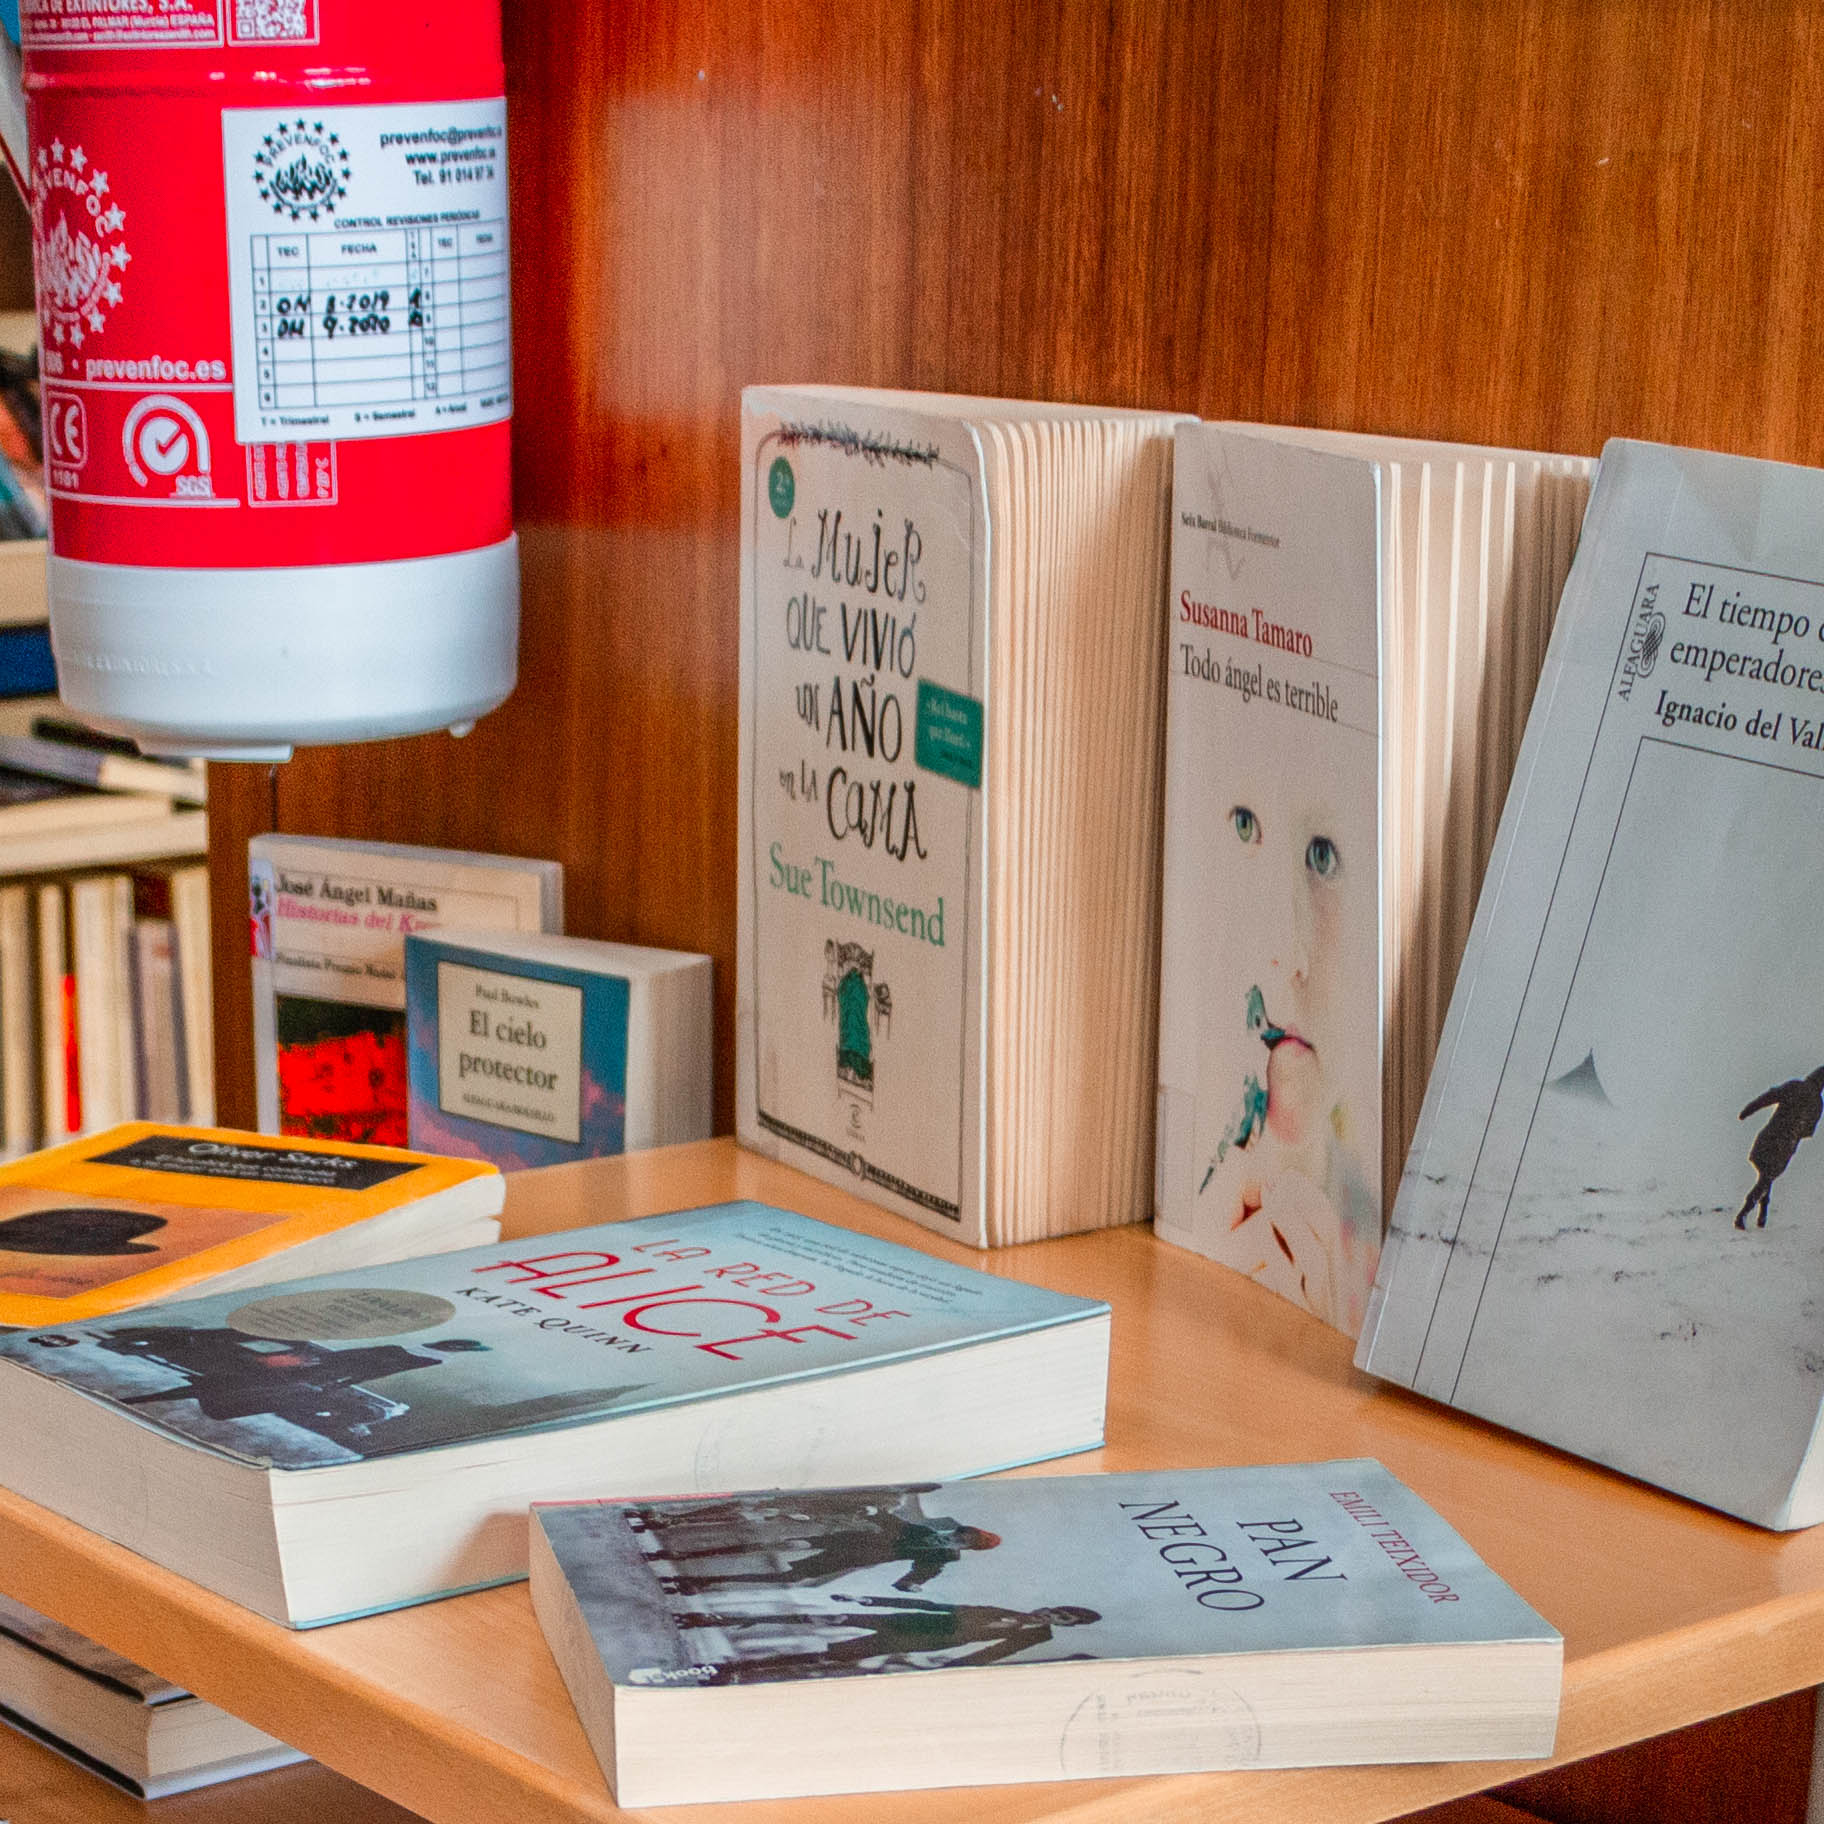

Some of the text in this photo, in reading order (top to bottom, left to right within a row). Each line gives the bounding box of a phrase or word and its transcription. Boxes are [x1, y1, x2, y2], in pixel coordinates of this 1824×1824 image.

[341, 243, 377, 254] FECHA
[86, 355, 226, 381] prevenfoc.es
[786, 594, 917, 680] QUE VIVIÓ
[1180, 589, 1314, 658] Susanna Tamaro
[1616, 583, 1661, 702] ALFAGUARA
[1681, 582, 1713, 619] El
[1718, 591, 1810, 645] tiempo
[826, 673, 903, 764] AÑO
[1180, 643, 1339, 724] Todo ángel es terrible
[1654, 689, 1738, 731] Ignacio
[1744, 708, 1781, 741] del
[769, 841, 945, 947] Sue Townsend
[469, 1009, 548, 1050] El cielo
[458, 1051, 559, 1092] protector
[452, 1285, 544, 1318] KATE
[530, 1313, 655, 1357] QUINN
[470, 1250, 860, 1362] ALICE
[630, 1238, 912, 1328] LA RED DE
[1116, 1498, 1267, 1614] NEGRO
[1235, 1517, 1350, 1582] PAN
[1328, 1489, 1461, 1605] EMILI TEIXIDOR
